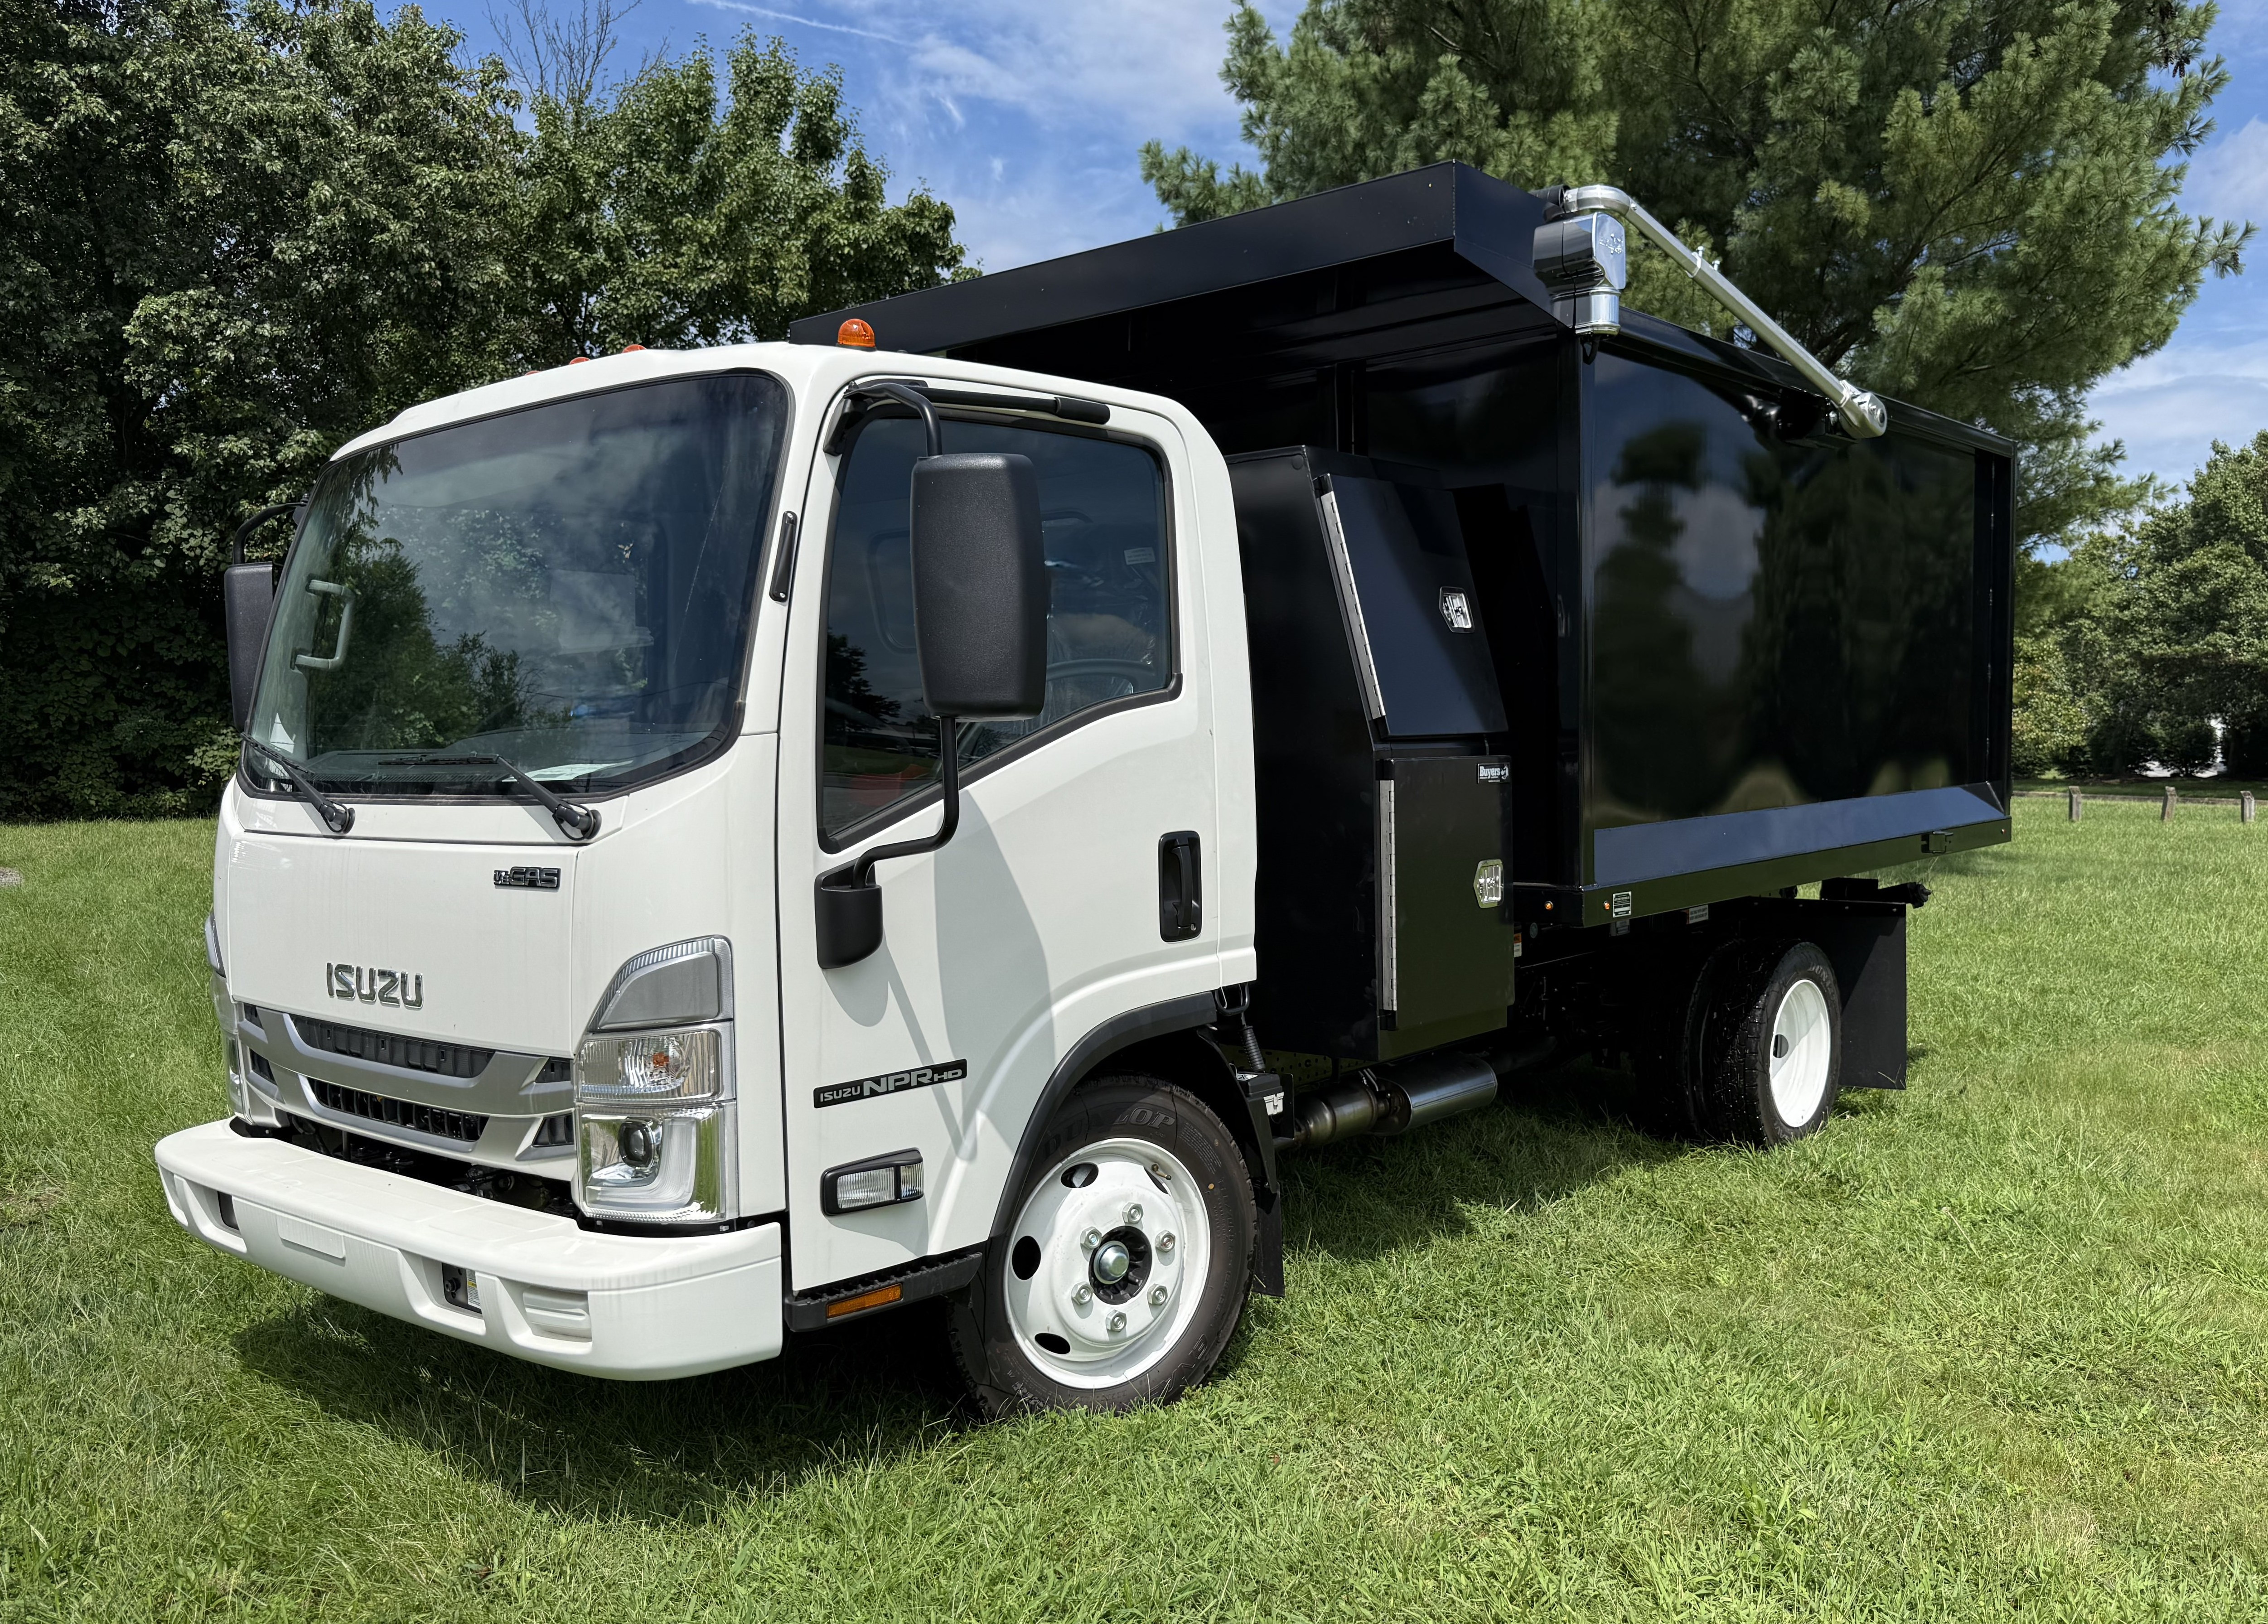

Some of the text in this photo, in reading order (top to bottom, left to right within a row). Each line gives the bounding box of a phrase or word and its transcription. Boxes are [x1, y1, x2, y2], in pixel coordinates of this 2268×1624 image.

[1480, 766, 1500, 778] Buyers
[510, 867, 558, 887] GAS
[326, 962, 424, 1010] ISUZU
[820, 1068, 962, 1102] ISUZU NPR HD
